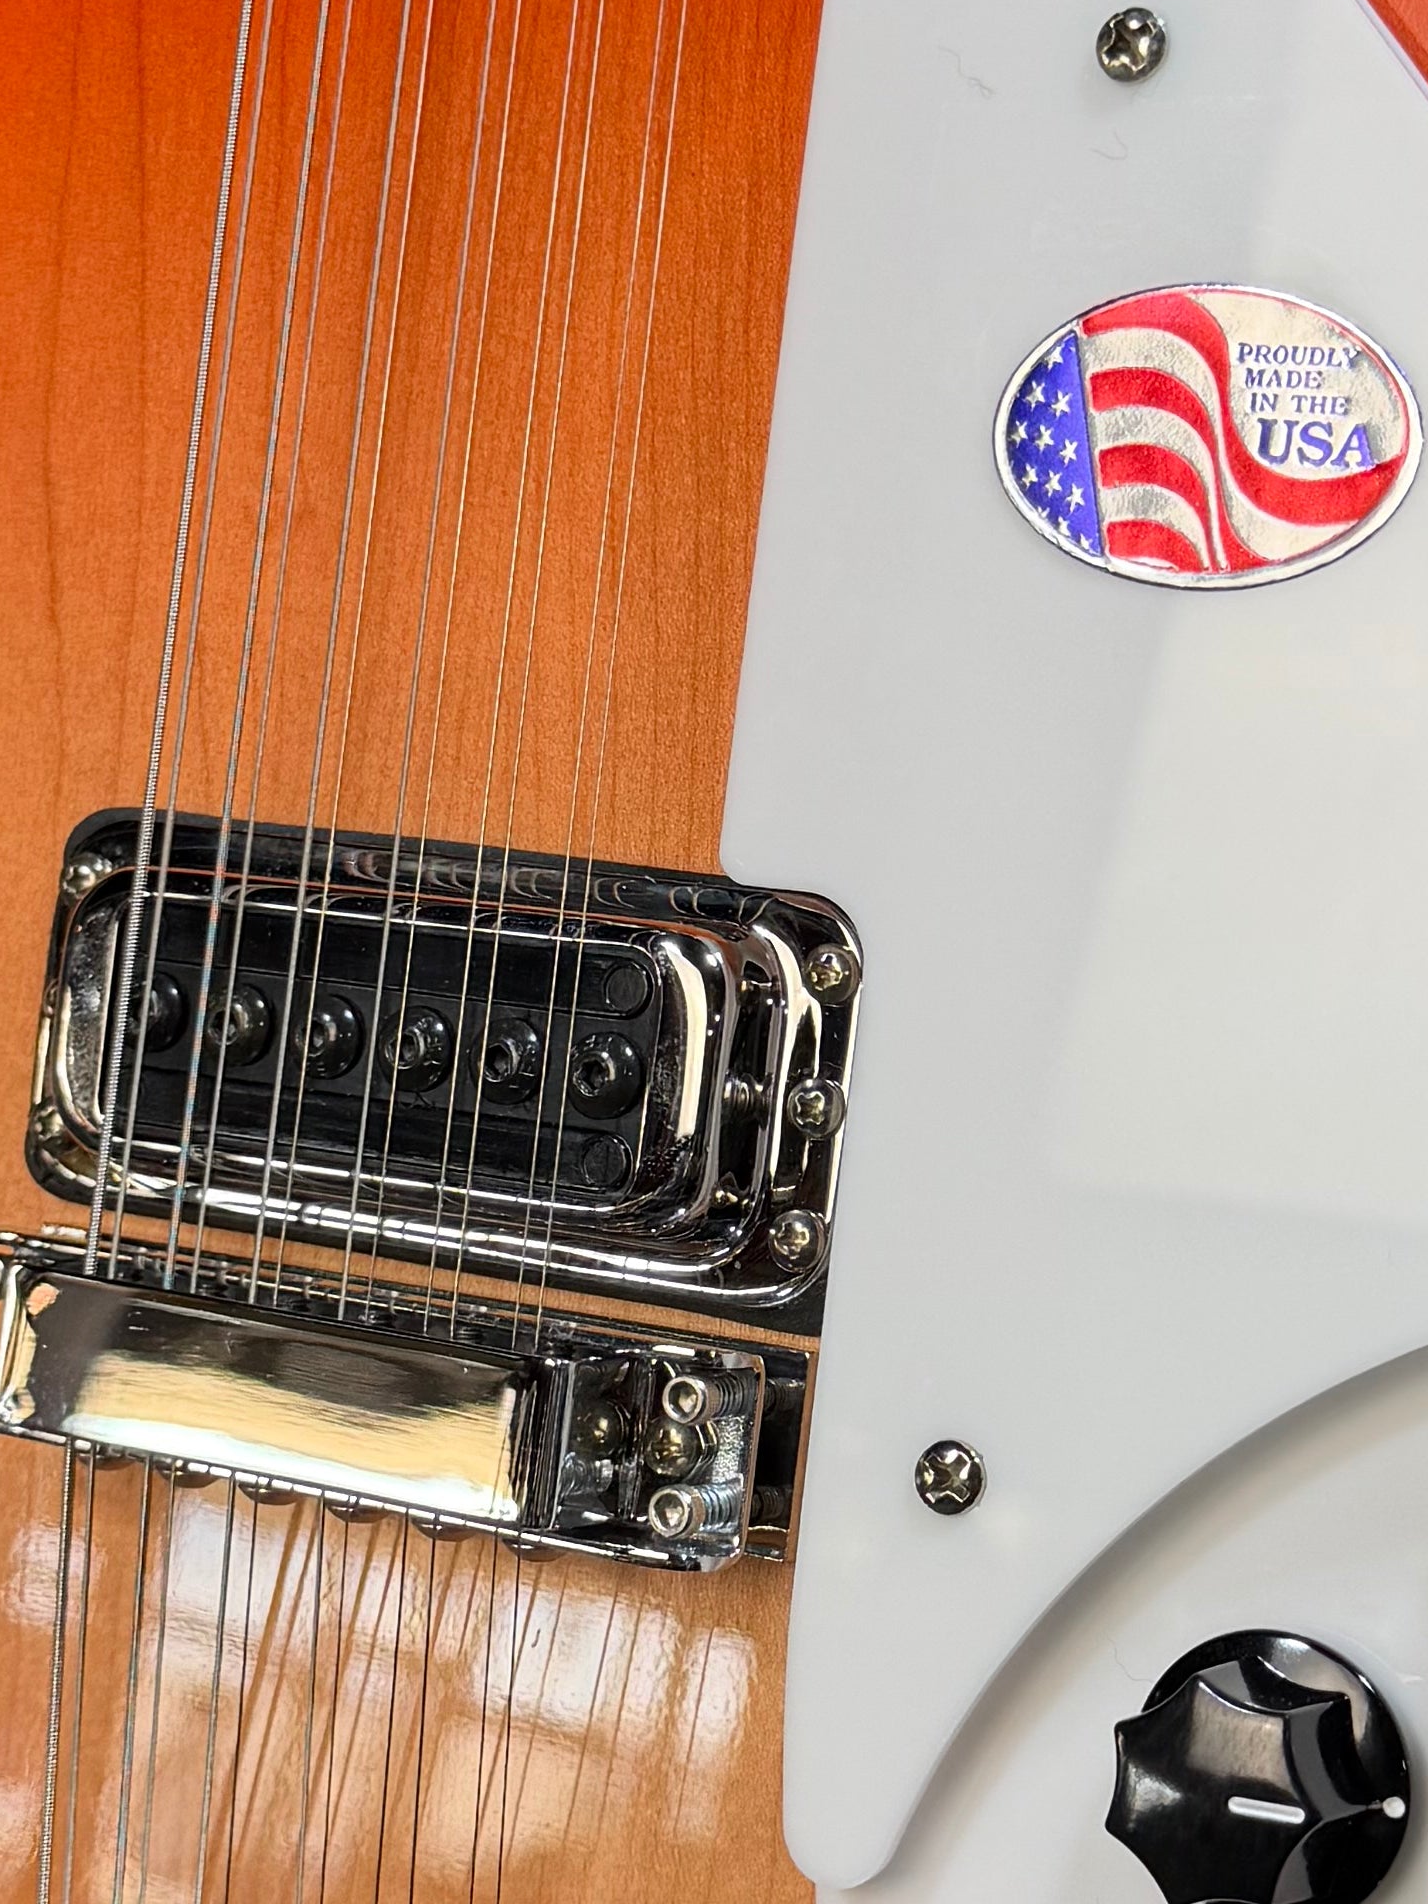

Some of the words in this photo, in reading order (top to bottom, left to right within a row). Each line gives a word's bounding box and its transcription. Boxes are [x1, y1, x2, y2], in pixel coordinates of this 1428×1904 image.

[1237, 342, 1359, 369] PROUDLY
[1245, 368, 1324, 390] MADE
[1250, 392, 1279, 413] IN
[1291, 394, 1352, 416] THE
[1257, 417, 1377, 469] USA
